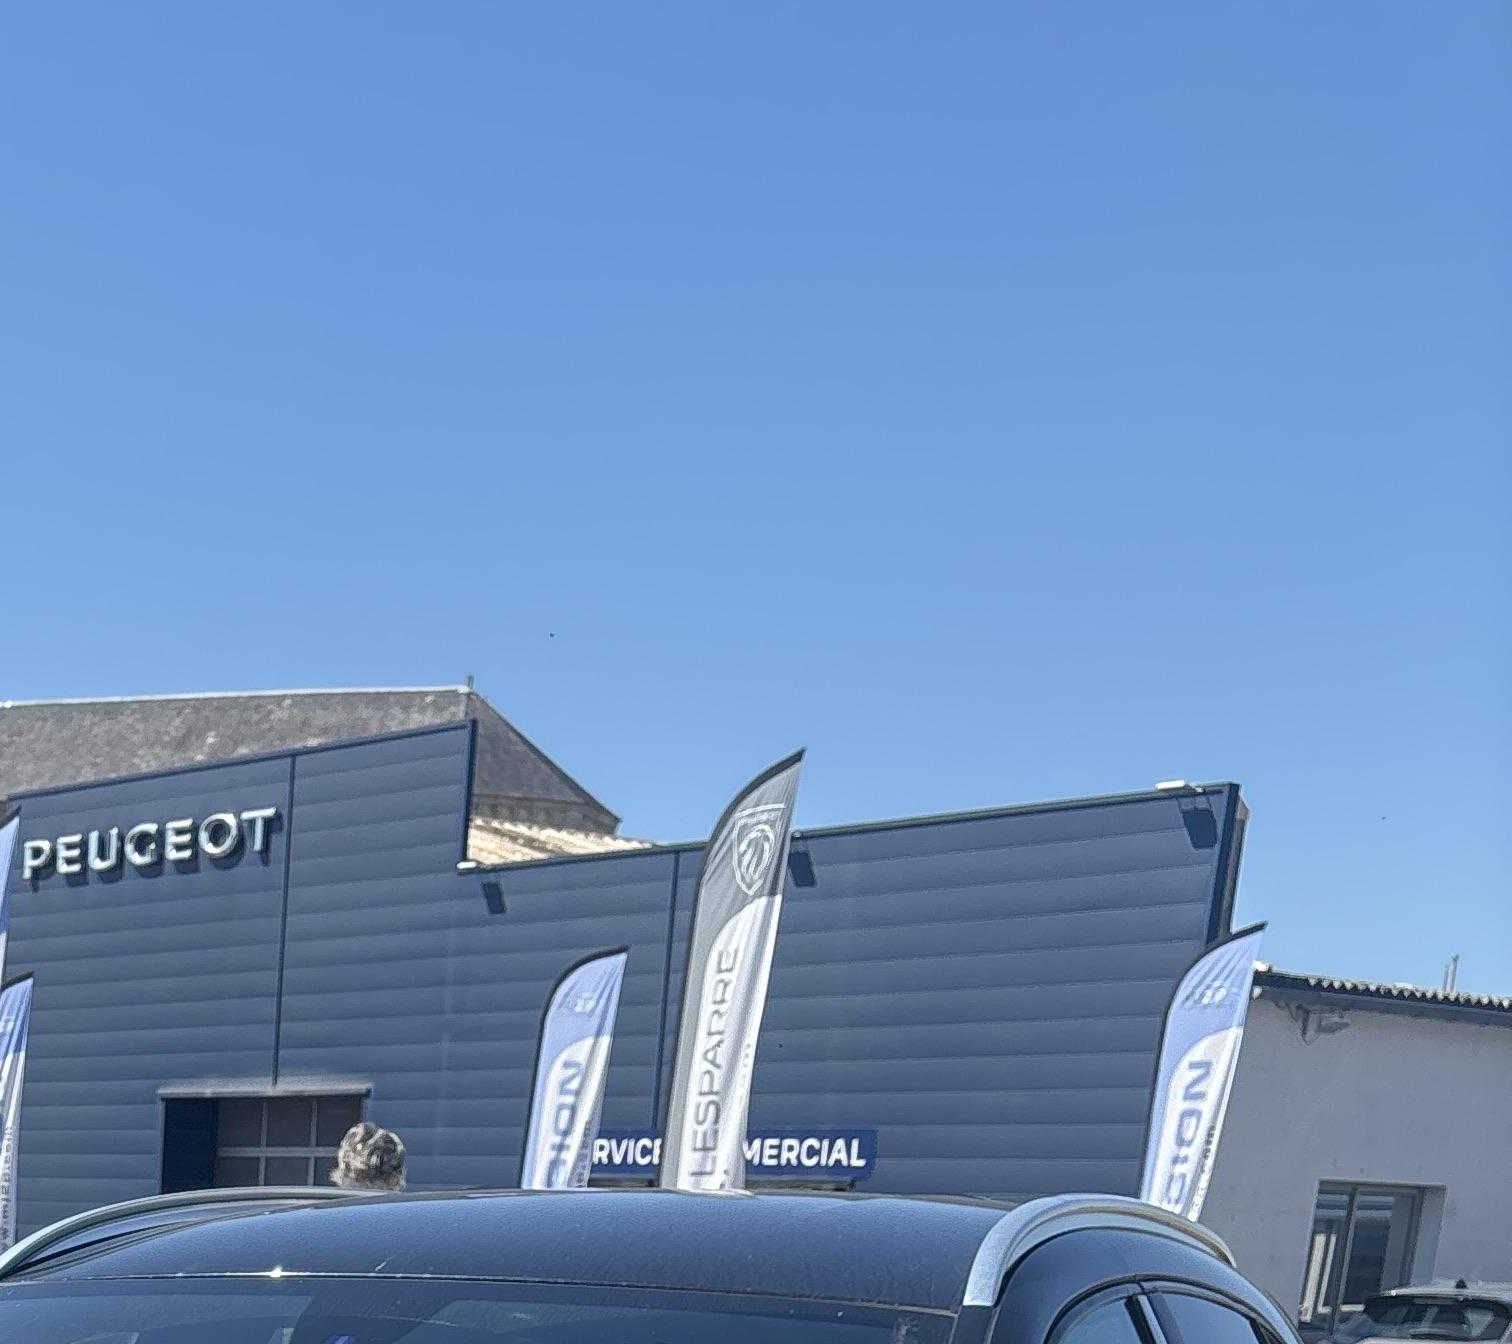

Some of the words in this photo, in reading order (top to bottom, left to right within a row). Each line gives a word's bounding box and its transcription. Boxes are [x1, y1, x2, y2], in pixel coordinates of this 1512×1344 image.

[22, 806, 278, 881] PEUGEOT
[691, 947, 739, 1178] LESPARRE
[742, 1137, 867, 1167] MERCIAL
